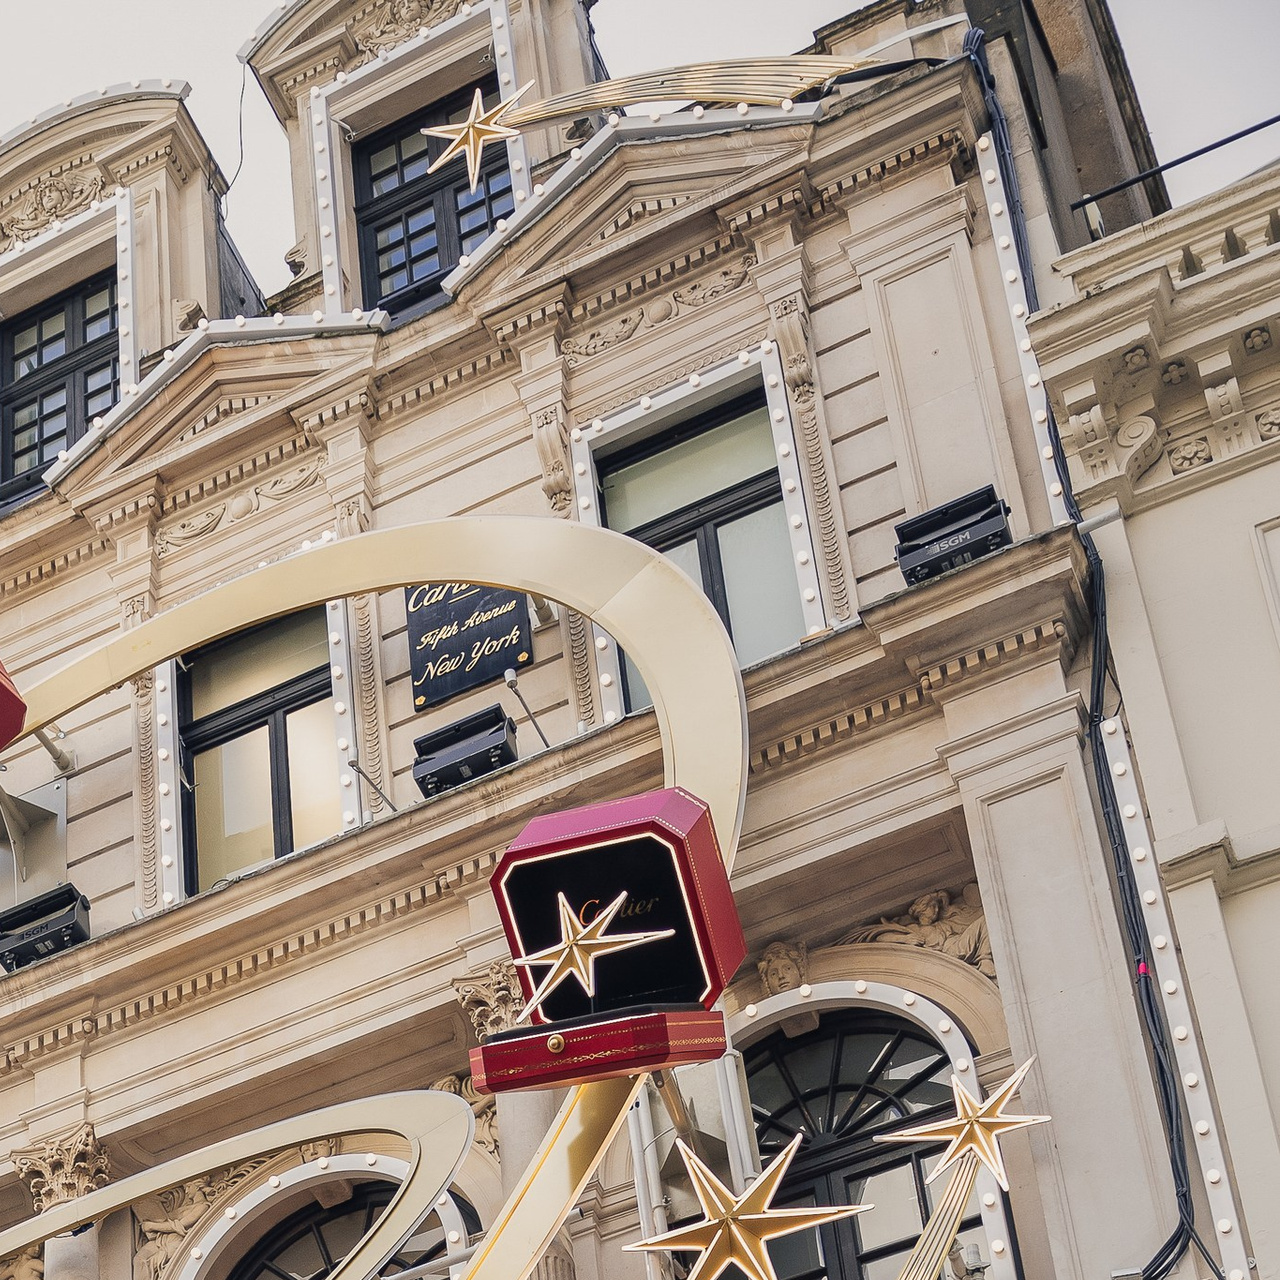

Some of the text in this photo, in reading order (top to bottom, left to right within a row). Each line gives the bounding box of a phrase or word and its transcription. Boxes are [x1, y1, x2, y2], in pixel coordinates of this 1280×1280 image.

[416, 600, 517, 651] Fifth Avenue
[413, 625, 521, 686] New York
[579, 897, 660, 926] Ctier
